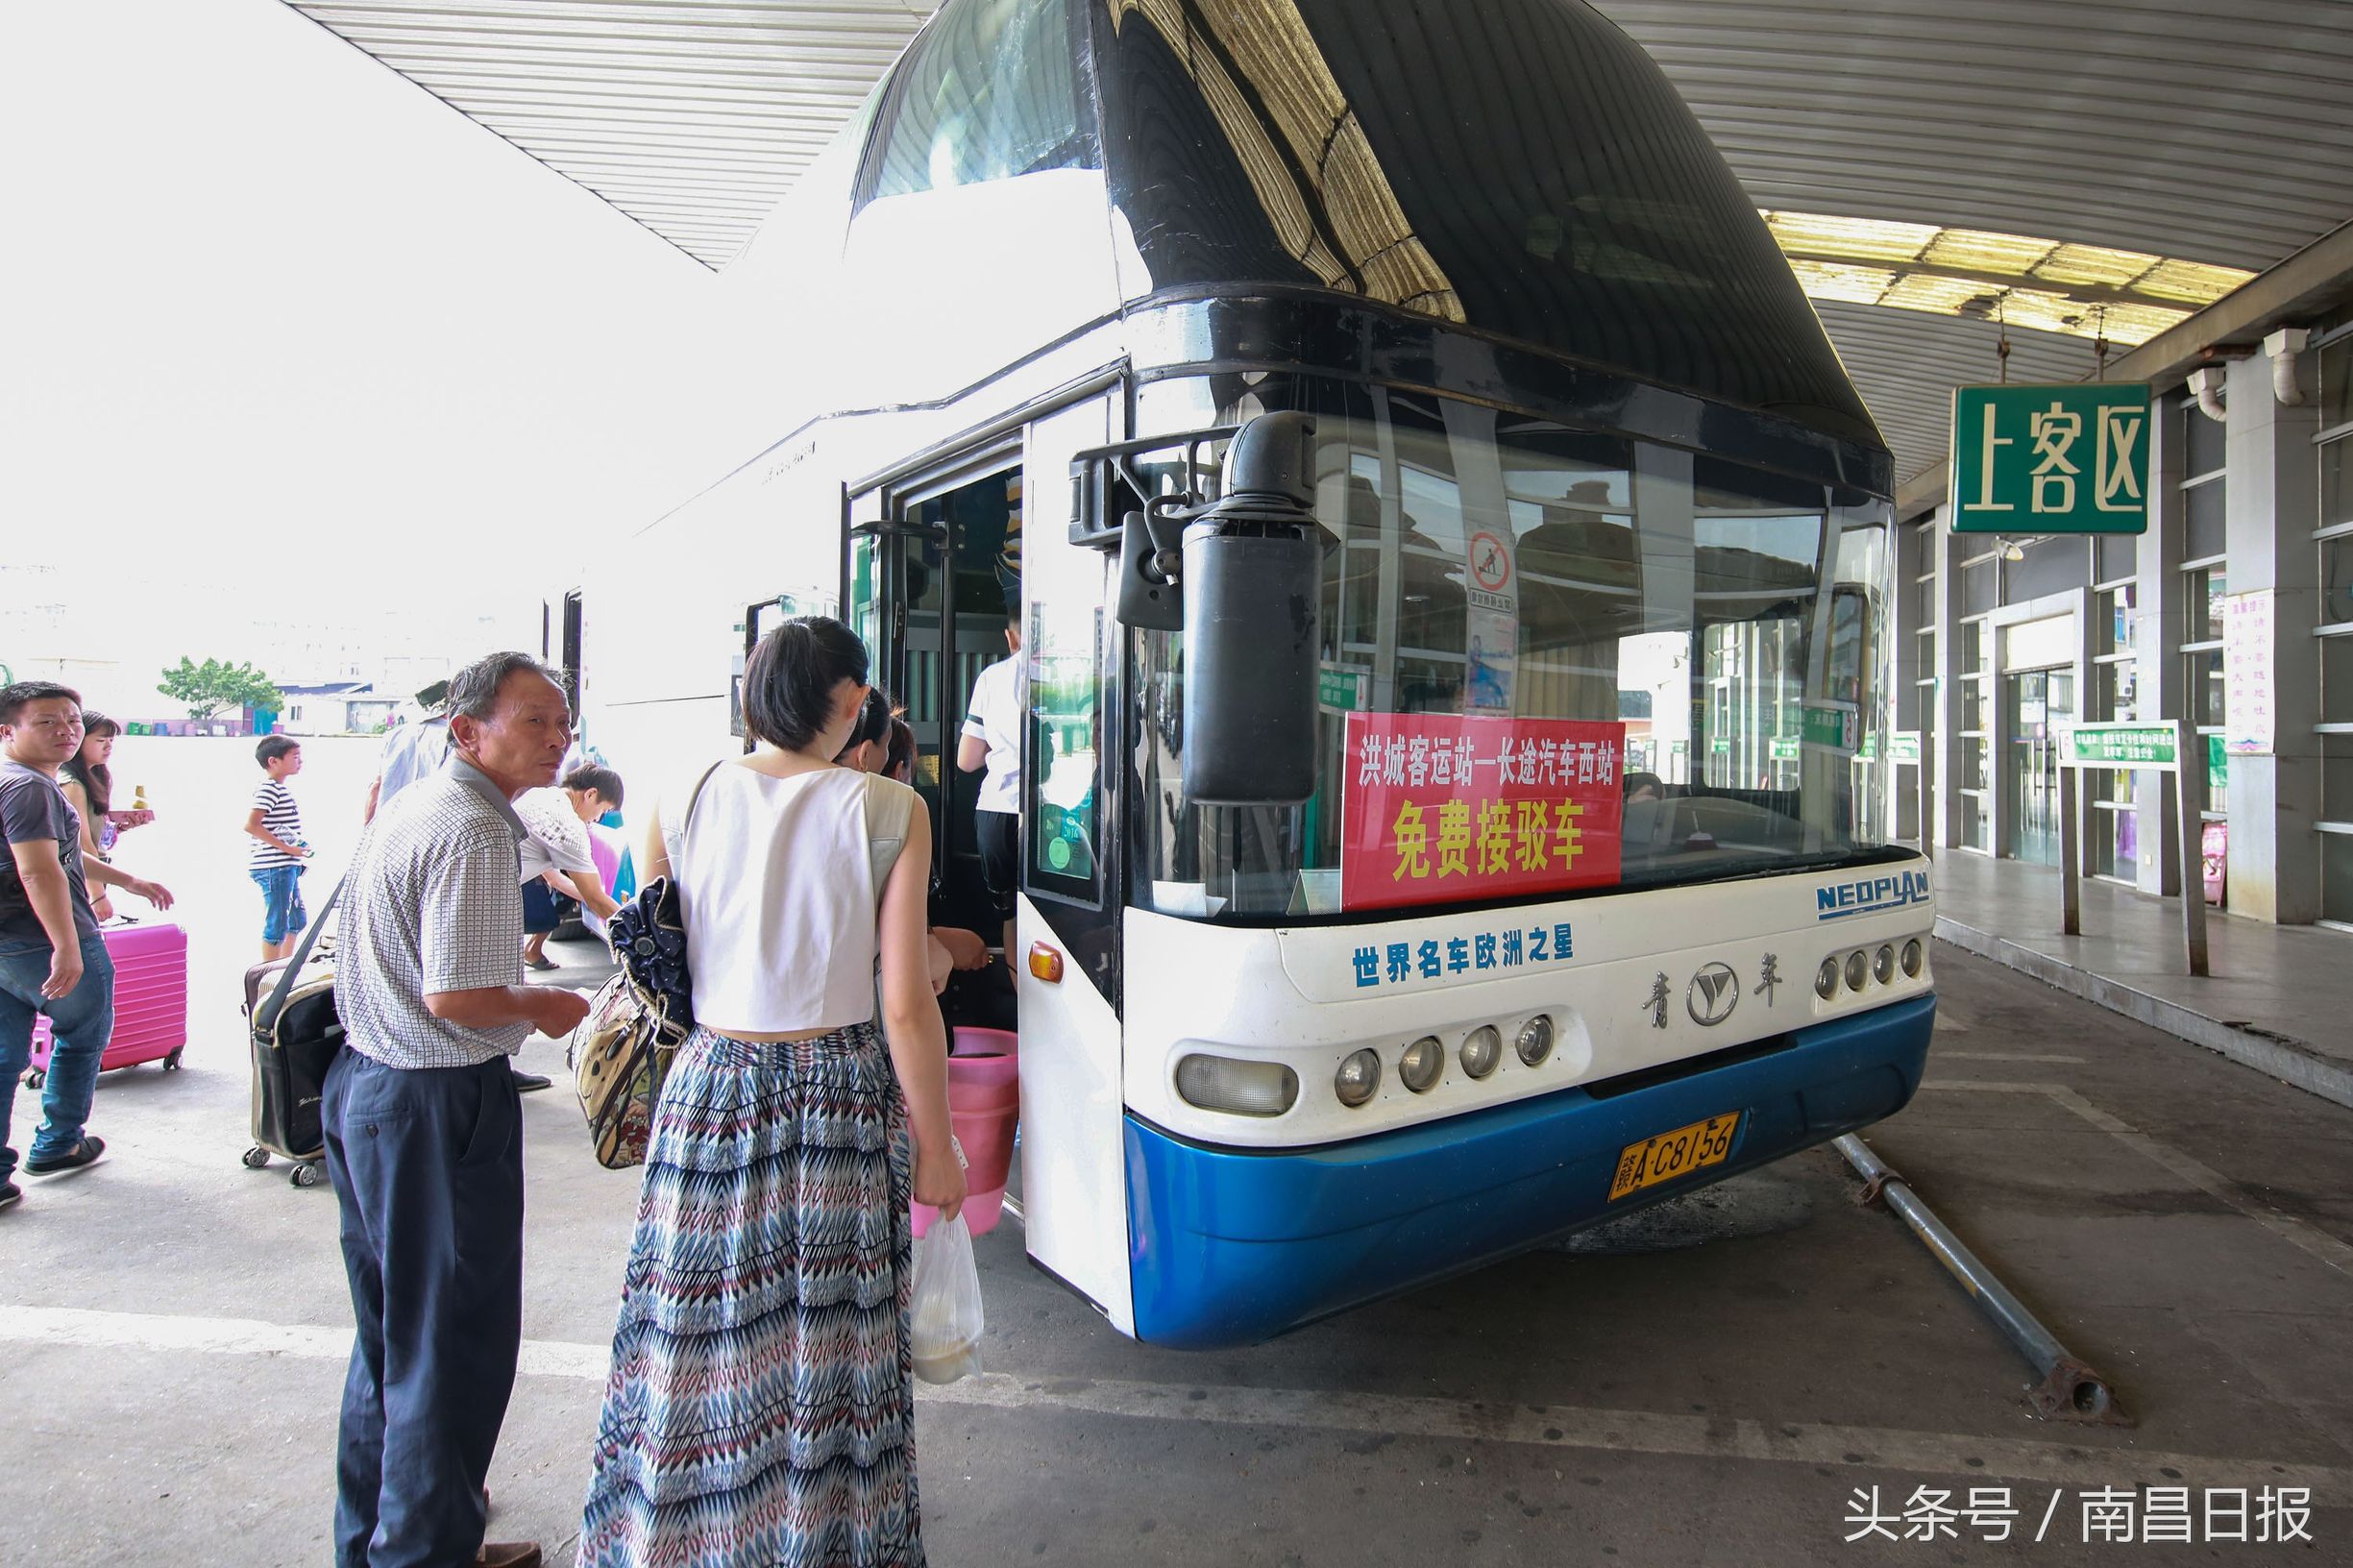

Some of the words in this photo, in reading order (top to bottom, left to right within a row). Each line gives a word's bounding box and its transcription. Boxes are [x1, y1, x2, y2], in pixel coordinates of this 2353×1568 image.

[1964, 402, 2145, 513] 上客区
[1392, 797, 1584, 882] 免费接驳车
[1817, 870, 1929, 912] NEOPLAN
[1353, 922, 1574, 988] 世界名车欧洲之星
